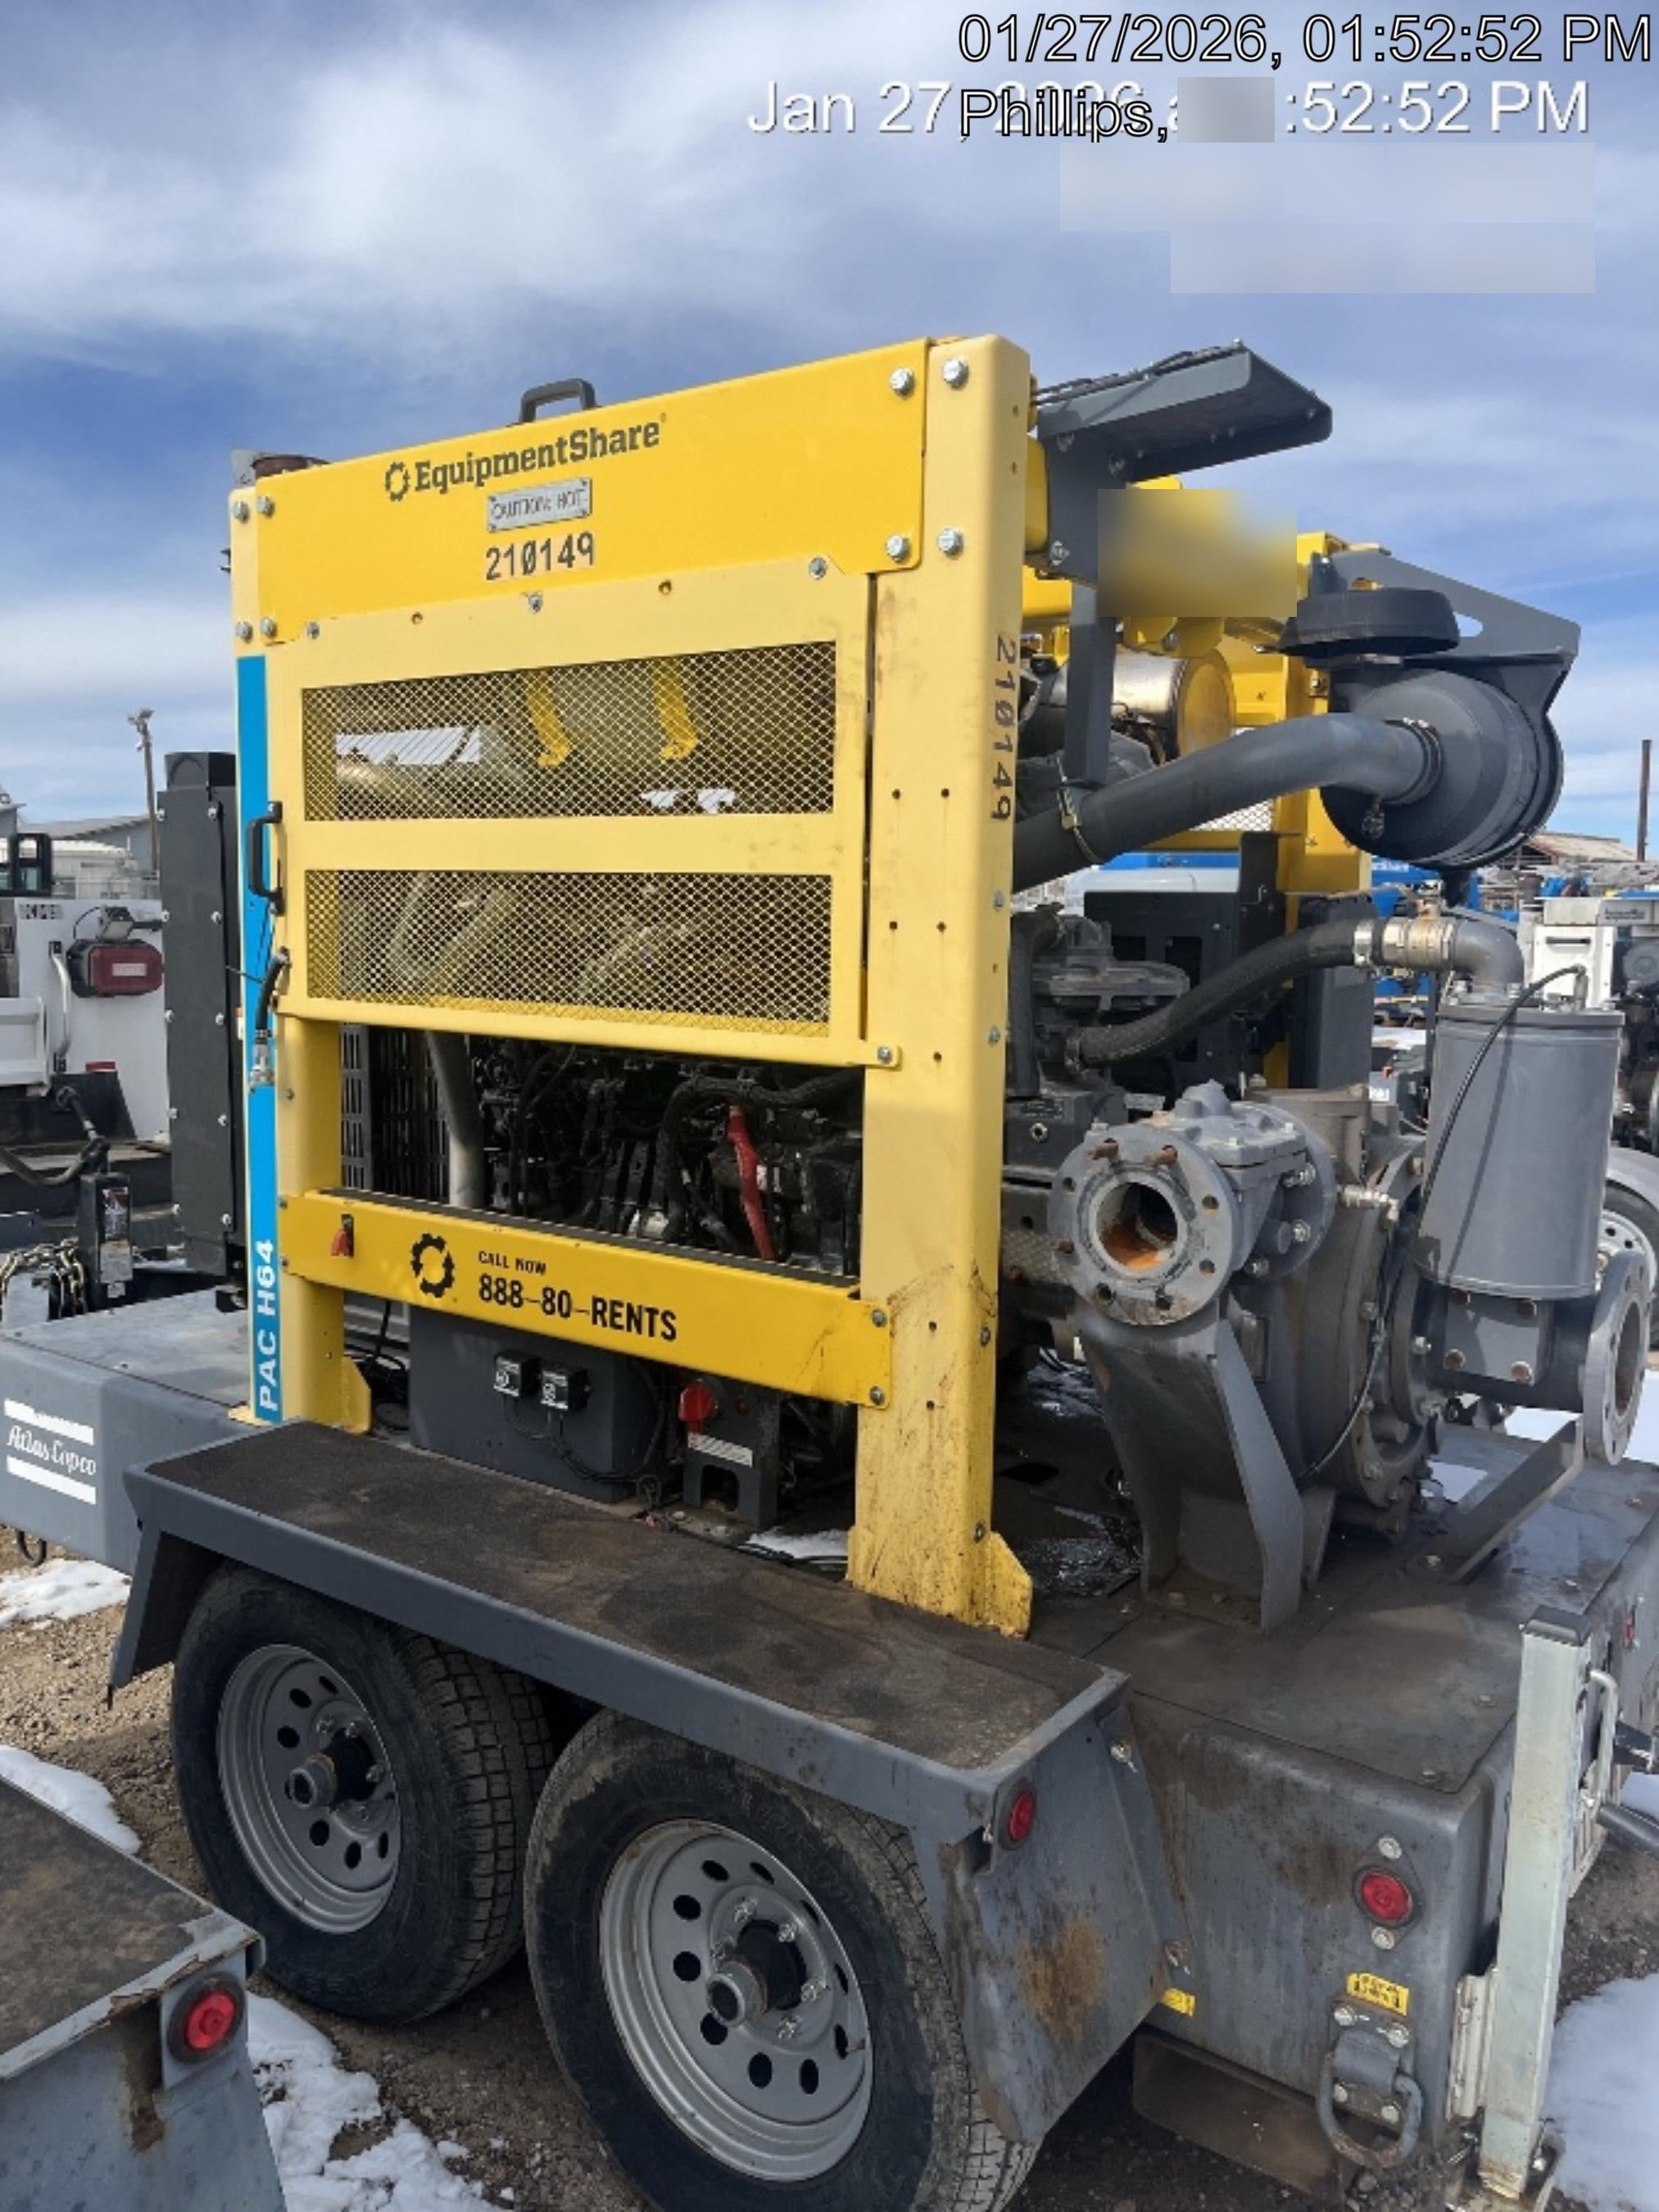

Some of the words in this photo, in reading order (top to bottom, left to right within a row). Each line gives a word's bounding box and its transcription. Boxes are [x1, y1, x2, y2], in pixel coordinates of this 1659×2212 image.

[415, 420, 660, 494] EquipmentShare
[557, 488, 585, 510] HOT
[485, 531, 594, 580] 210149
[990, 635, 1017, 820] 210149
[255, 1239, 276, 1317] H64
[478, 1250, 510, 1269] CALL
[515, 1258, 546, 1276] NOW
[479, 1273, 677, 1341] 888-80-RENTS
[256, 1329, 279, 1412] PAC
[6, 1425, 49, 1461] Atlas
[51, 1439, 97, 1475] Copco
